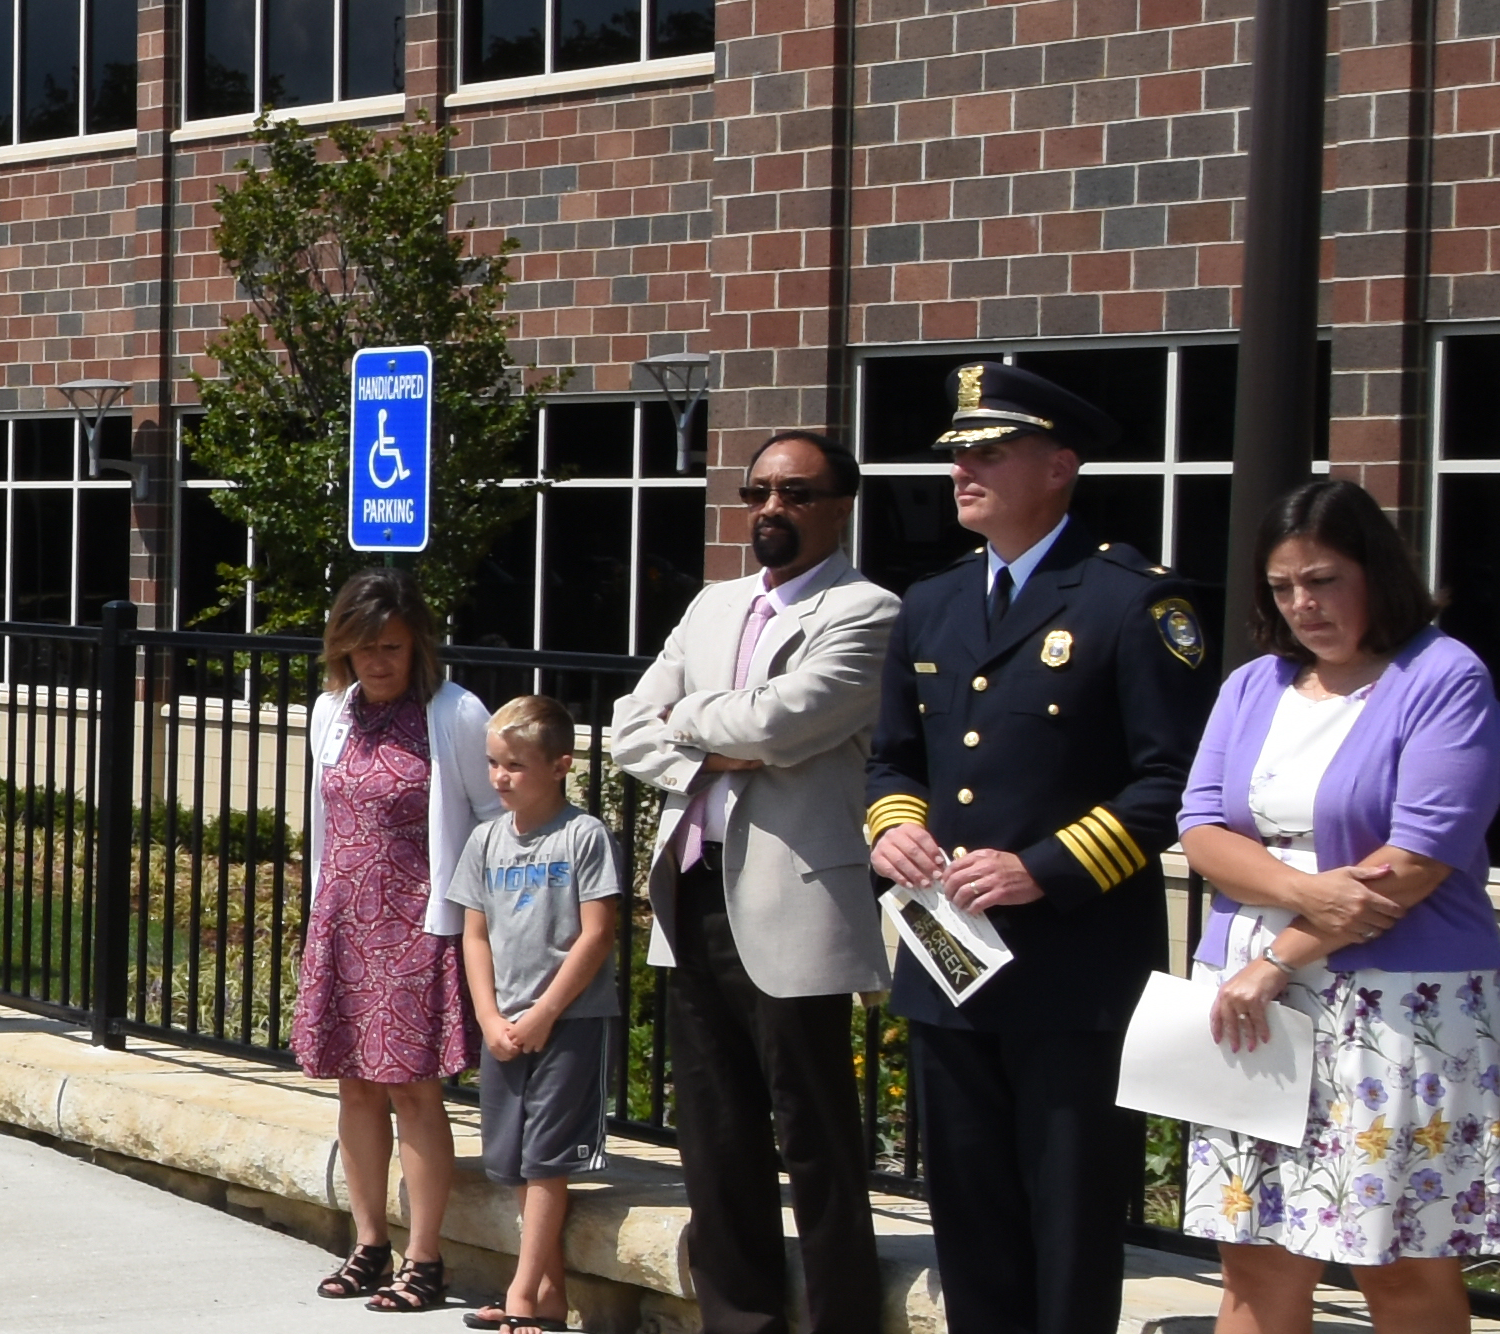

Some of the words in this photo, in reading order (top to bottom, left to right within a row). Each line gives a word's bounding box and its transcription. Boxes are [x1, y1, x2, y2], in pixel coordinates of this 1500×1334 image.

[358, 374, 424, 401] HANDICAPPED
[363, 498, 414, 525] PARKING
[931, 929, 970, 985] CREEK
